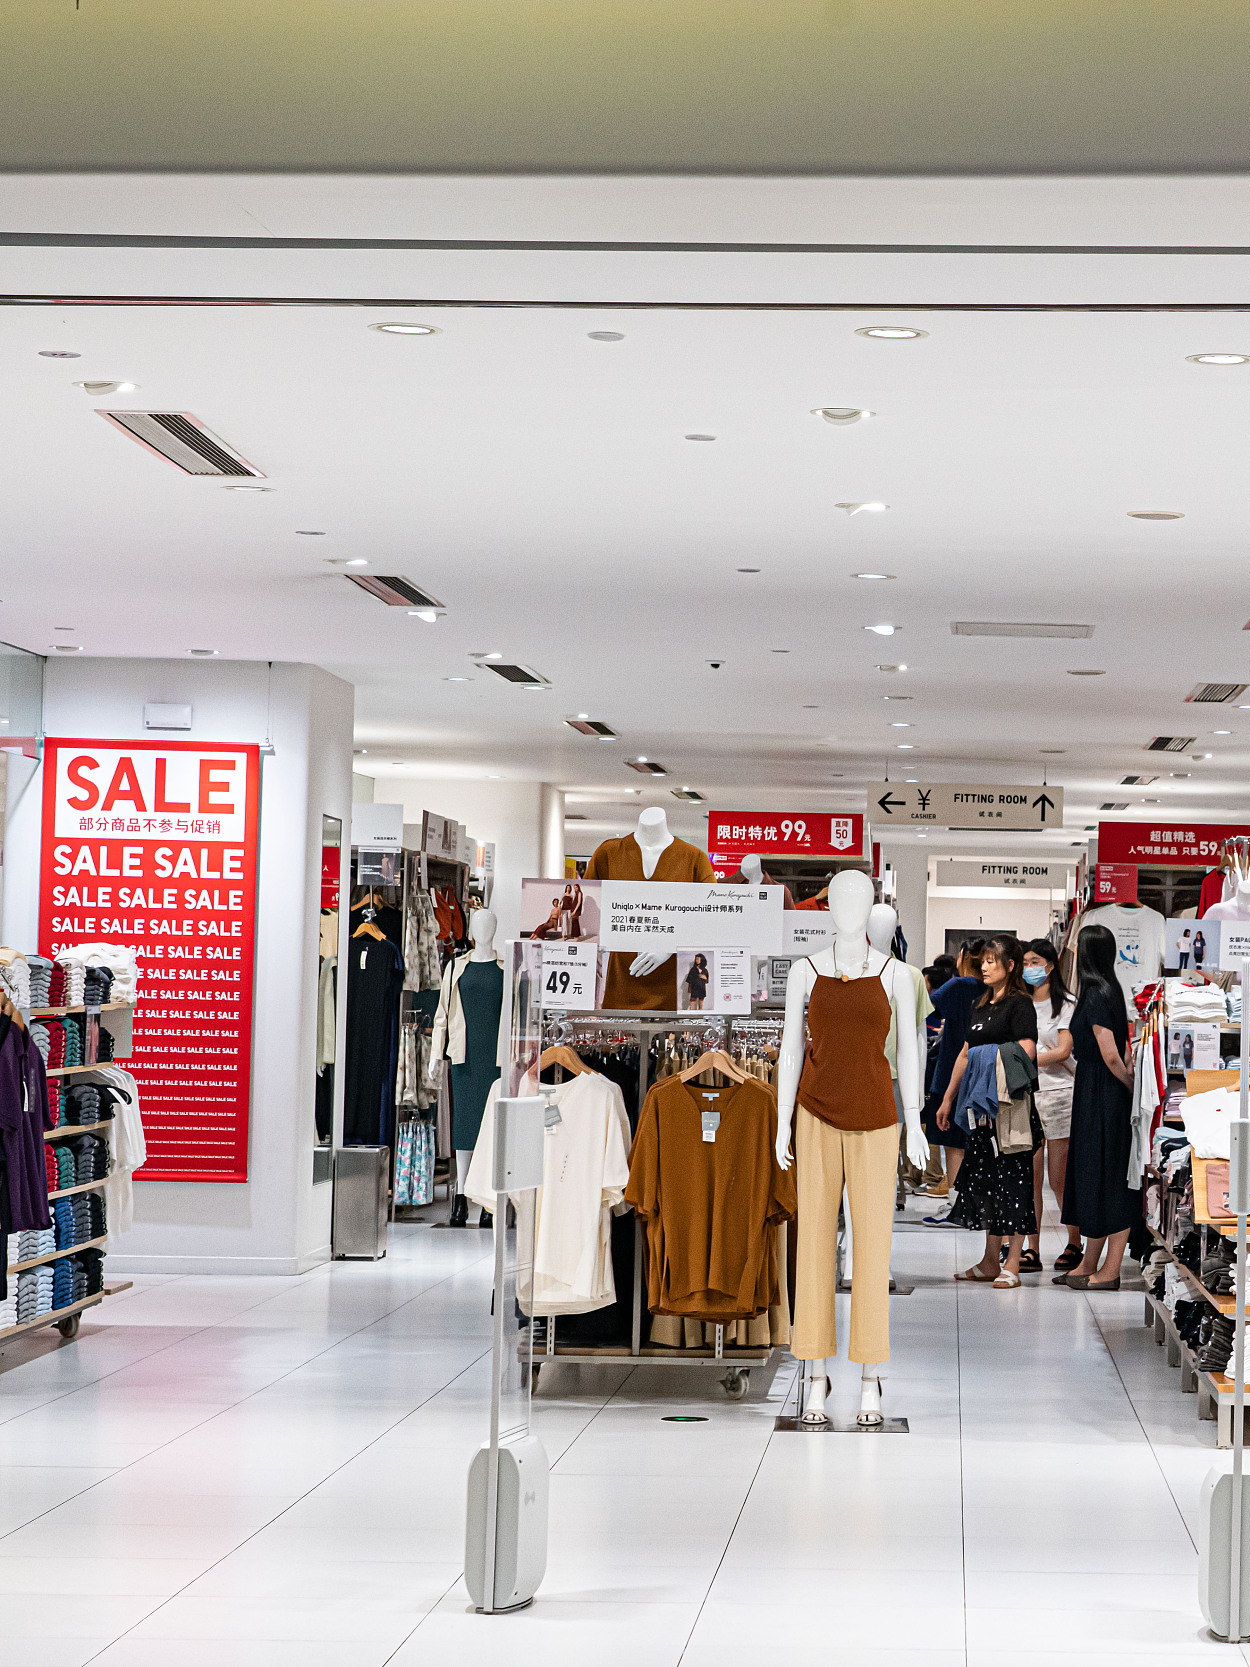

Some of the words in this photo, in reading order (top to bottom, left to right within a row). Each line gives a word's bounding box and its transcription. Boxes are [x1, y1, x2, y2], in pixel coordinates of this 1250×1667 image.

[67, 756, 236, 814] SALE
[954, 794, 994, 804] FITTING
[999, 795, 1027, 804] ROOM
[79, 817, 221, 834] 部分商品不参与促销
[836, 829, 847, 839] 50
[1150, 830, 1195, 843] 超值精选
[1129, 846, 1178, 855] 人气明星单品
[53, 845, 144, 877] SALE
[154, 847, 244, 879] SALE
[982, 865, 1018, 875] FITTING
[1023, 867, 1048, 875] ROOM
[1100, 882, 1111, 893] 59
[53, 886, 112, 907] SALE
[119, 888, 177, 909] SALE
[184, 889, 243, 910] SALE
[665, 903, 743, 913] Kurogouchi设计师系列
[611, 916, 659, 924] 2021春夏新品
[52, 917, 96, 933] SALE
[101, 918, 145, 934] SALE
[150, 919, 193, 935] SALE
[198, 921, 242, 936] SALE
[644, 925, 674, 933] 浑然天成
[51, 944, 74, 957] SA
[168, 946, 202, 959] SALE
[206, 947, 241, 960] SALE
[147, 969, 176, 979] SALE
[179, 970, 208, 980] SALE
[211, 971, 240, 981] SALE
[546, 971, 570, 993] 49
[573, 984, 582, 994] 元
[160, 990, 185, 999] SALE
[187, 991, 212, 1000] SALE
[215, 992, 240, 1001] SALE
[145, 1010, 166, 1018] SALE
[193, 1011, 215, 1019] SALE
